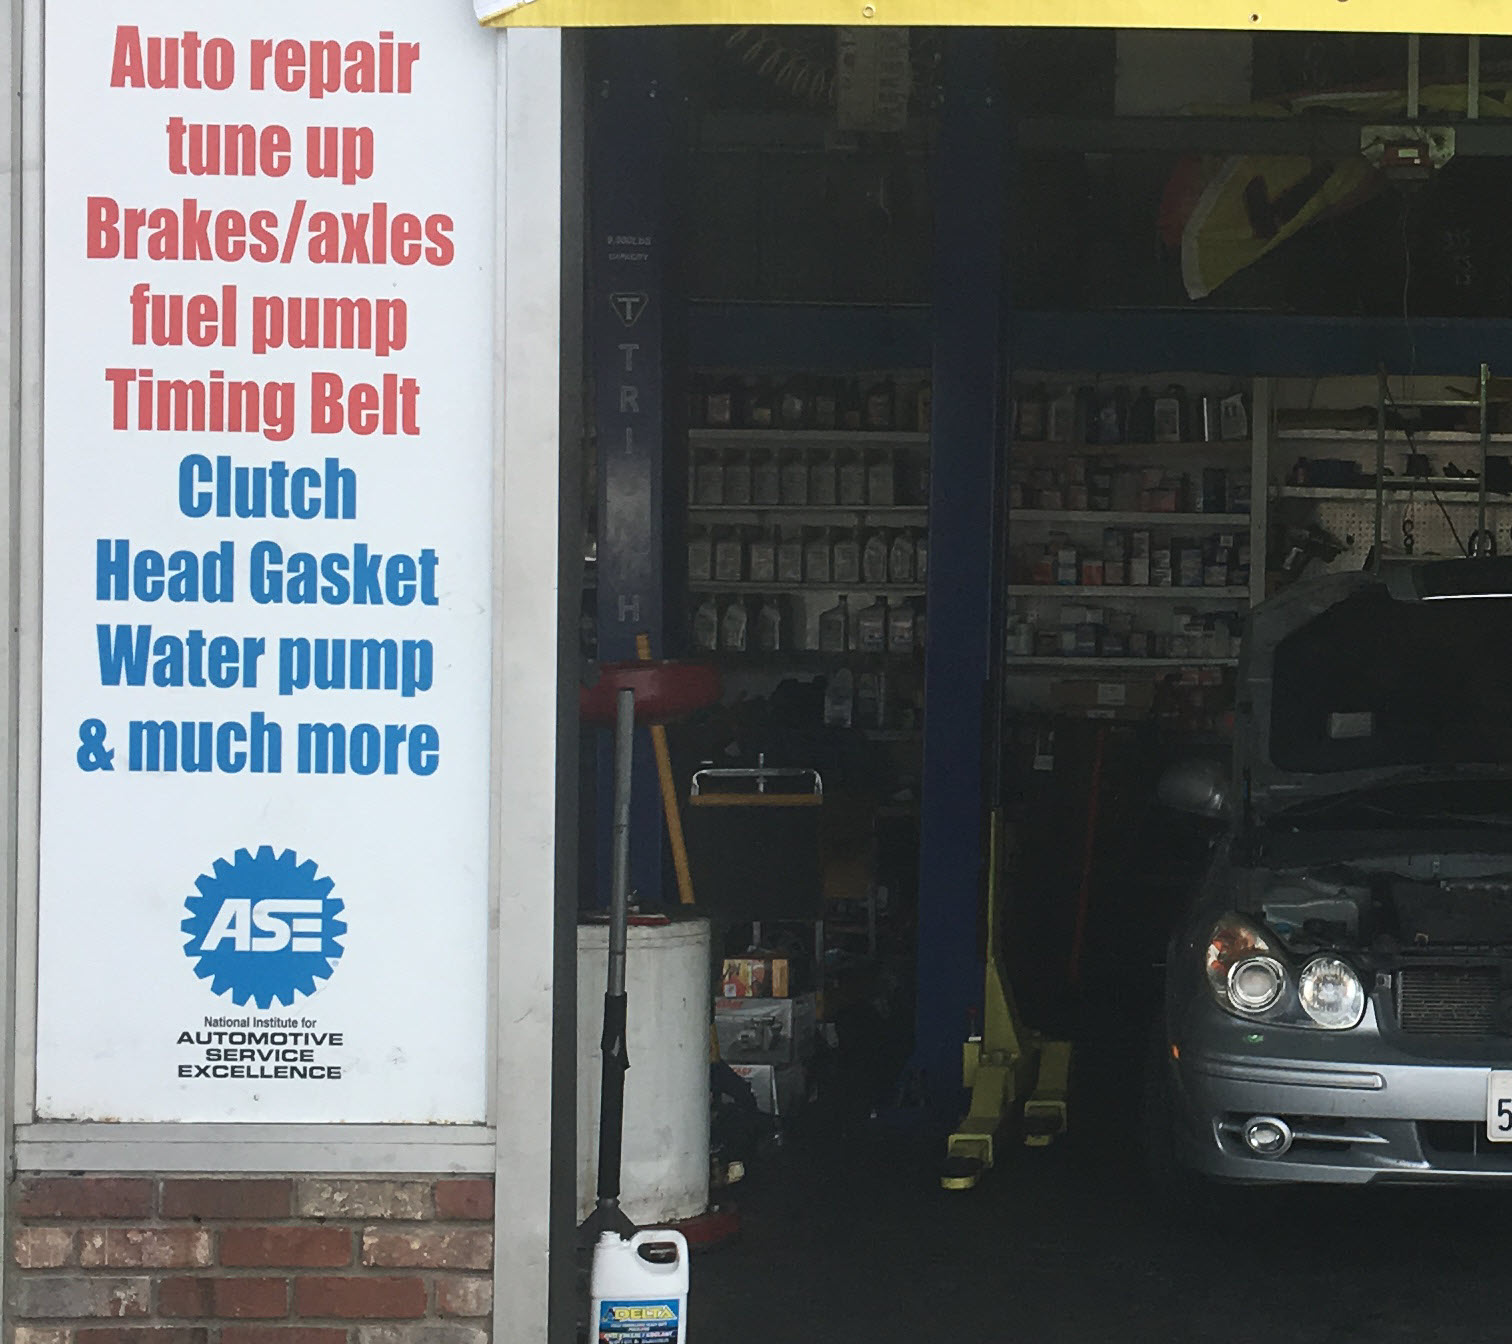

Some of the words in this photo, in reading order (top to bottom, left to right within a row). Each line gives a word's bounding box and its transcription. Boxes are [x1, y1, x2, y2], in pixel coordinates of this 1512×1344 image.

[109, 24, 235, 90] Auto
[249, 30, 421, 100] repair
[166, 116, 292, 178] tune
[306, 125, 375, 186] up
[86, 196, 456, 267] Brakes/axles
[129, 283, 238, 348] fuel
[251, 293, 408, 357] pump
[105, 367, 295, 442] Timing
[310, 372, 421, 437] Belt
[178, 452, 357, 520] Clutch
[95, 538, 235, 604] Head
[249, 541, 440, 607] Gasket
[96, 622, 266, 689] Water
[278, 637, 434, 697] pump
[76, 717, 115, 773] &
[127, 711, 282, 774] much
[298, 722, 440, 777] more
[200, 898, 323, 952] ASE
[176, 1031, 344, 1047] AUTOMOTIVE
[203, 1016, 250, 1028] National
[252, 1016, 297, 1028] Institute
[300, 1017, 317, 1029] for
[205, 1048, 315, 1063] SERVICE
[177, 1064, 342, 1081] EXCELLENCE
[614, 1306, 676, 1320] DELTA
